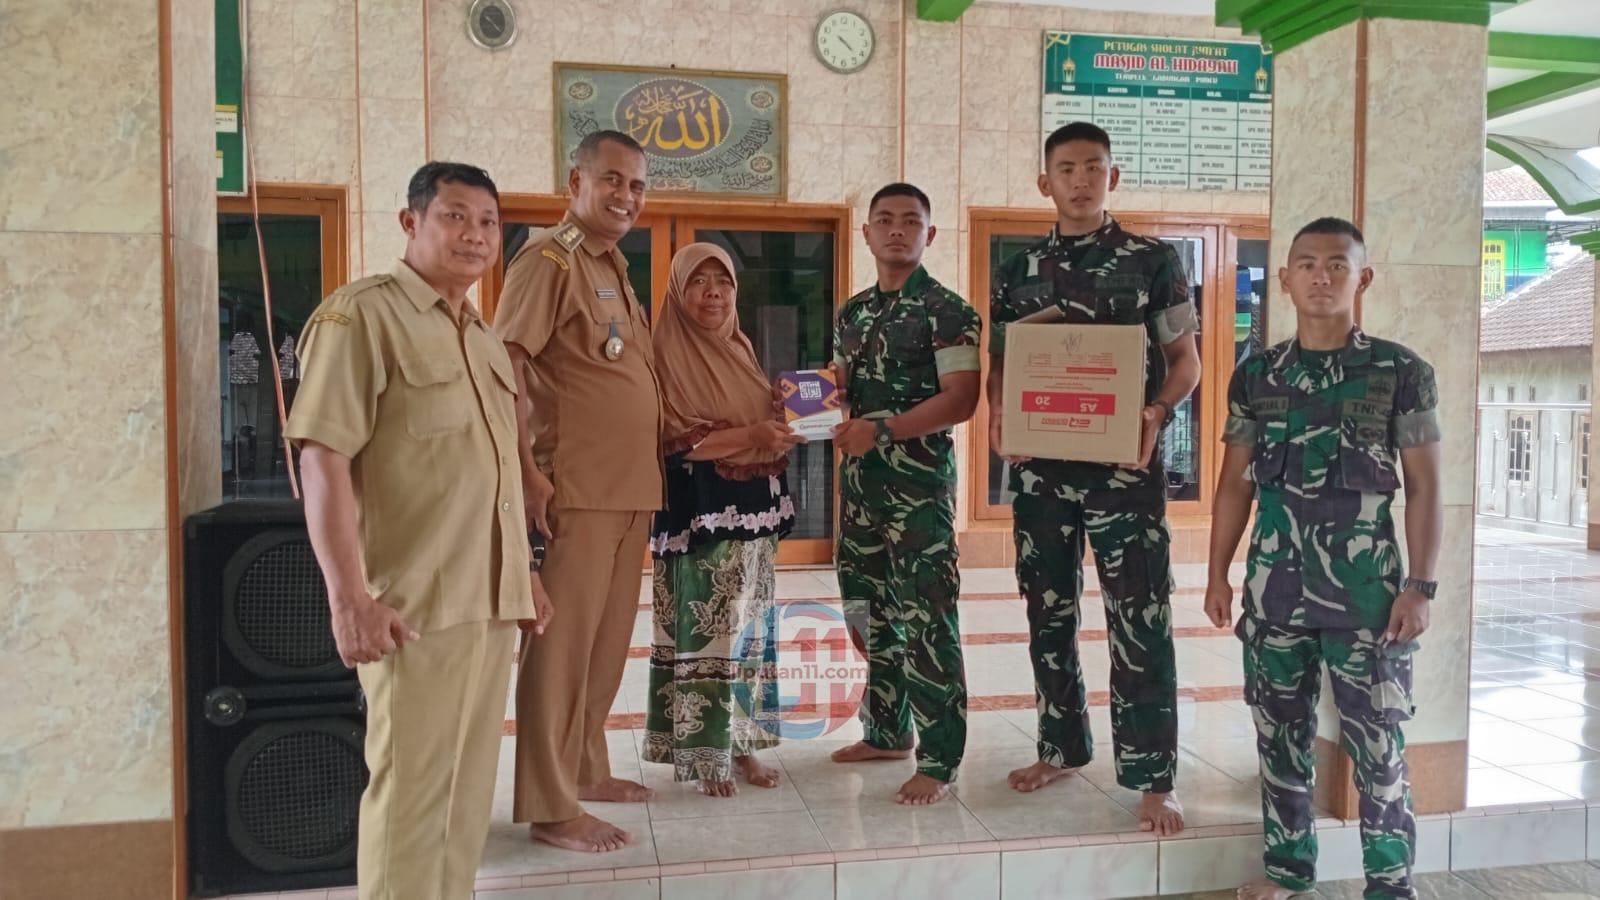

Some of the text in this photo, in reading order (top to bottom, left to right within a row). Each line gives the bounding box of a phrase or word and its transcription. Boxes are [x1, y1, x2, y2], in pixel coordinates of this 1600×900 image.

[1103, 41, 1147, 52] PETUGAS
[1151, 43, 1188, 54] SHOLAT
[1094, 53, 1146, 72] MASJID
[1171, 57, 1239, 75] HIDAYAH
[1035, 395, 1051, 406] 20
